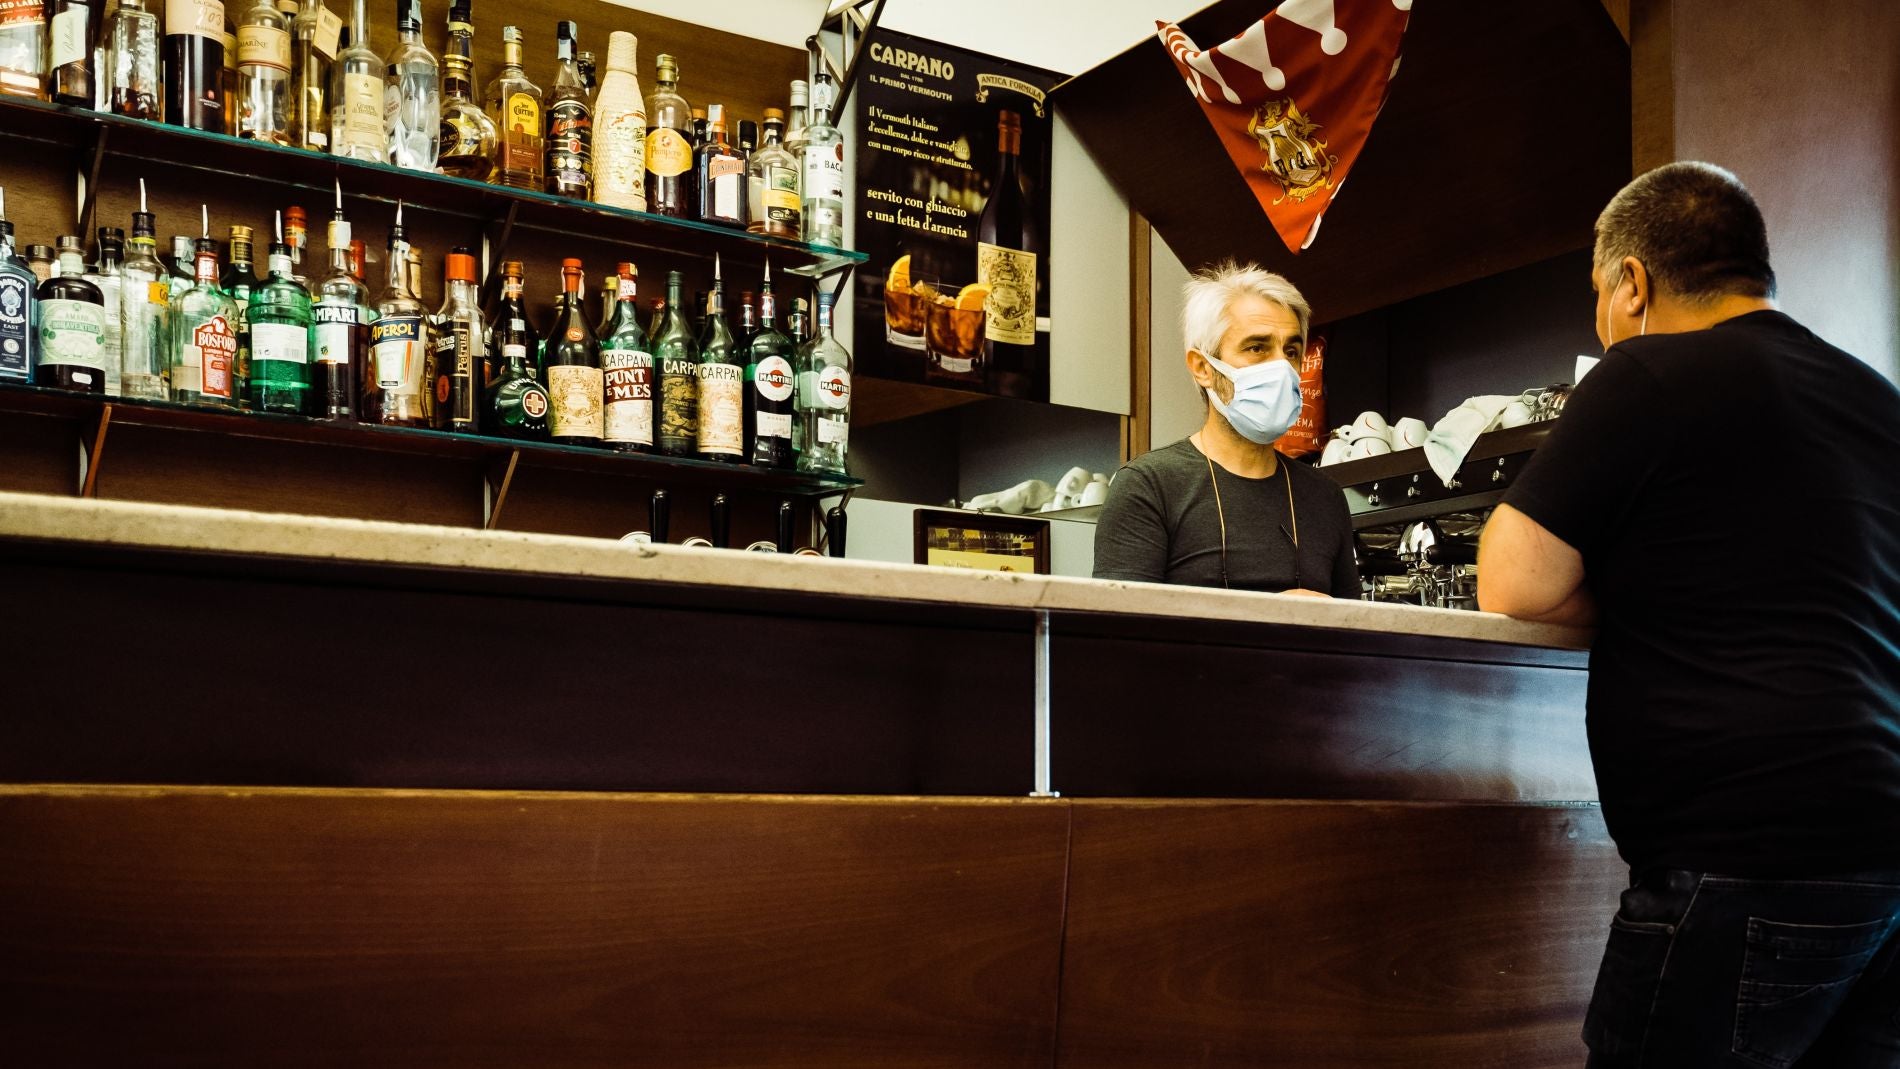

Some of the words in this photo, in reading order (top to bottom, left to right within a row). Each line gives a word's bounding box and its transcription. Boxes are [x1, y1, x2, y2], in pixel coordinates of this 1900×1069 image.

[870, 42, 954, 80] CARPANO
[869, 74, 878, 83] IL
[880, 77, 906, 90] PRIMO
[908, 84, 953, 102] VERMOUTH
[981, 75, 1008, 87] ANTICA
[1009, 79, 1042, 100] FORMULA
[869, 105, 875, 117] Il
[876, 107, 911, 126] Vermouth
[912, 116, 938, 132] Italiano
[911, 130, 929, 145] dolce
[867, 140, 881, 149] con
[882, 143, 892, 151] un
[893, 147, 913, 157] corpo
[913, 149, 930, 160] ricco
[867, 189, 903, 204] servito
[904, 197, 923, 209] con
[925, 195, 967, 218] ghiaccio
[866, 210, 873, 218] e
[875, 211, 895, 223] una
[897, 208, 920, 229] fetta
[922, 214, 968, 238] d'arancia
[197, 331, 238, 353] BOSFORD
[371, 322, 415, 341] APEROL
[457, 333, 468, 374] Petrus
[605, 369, 645, 387] PUNT
[758, 373, 793, 386] MARTINI
[606, 387, 612, 396] E
[613, 383, 652, 399] MES
